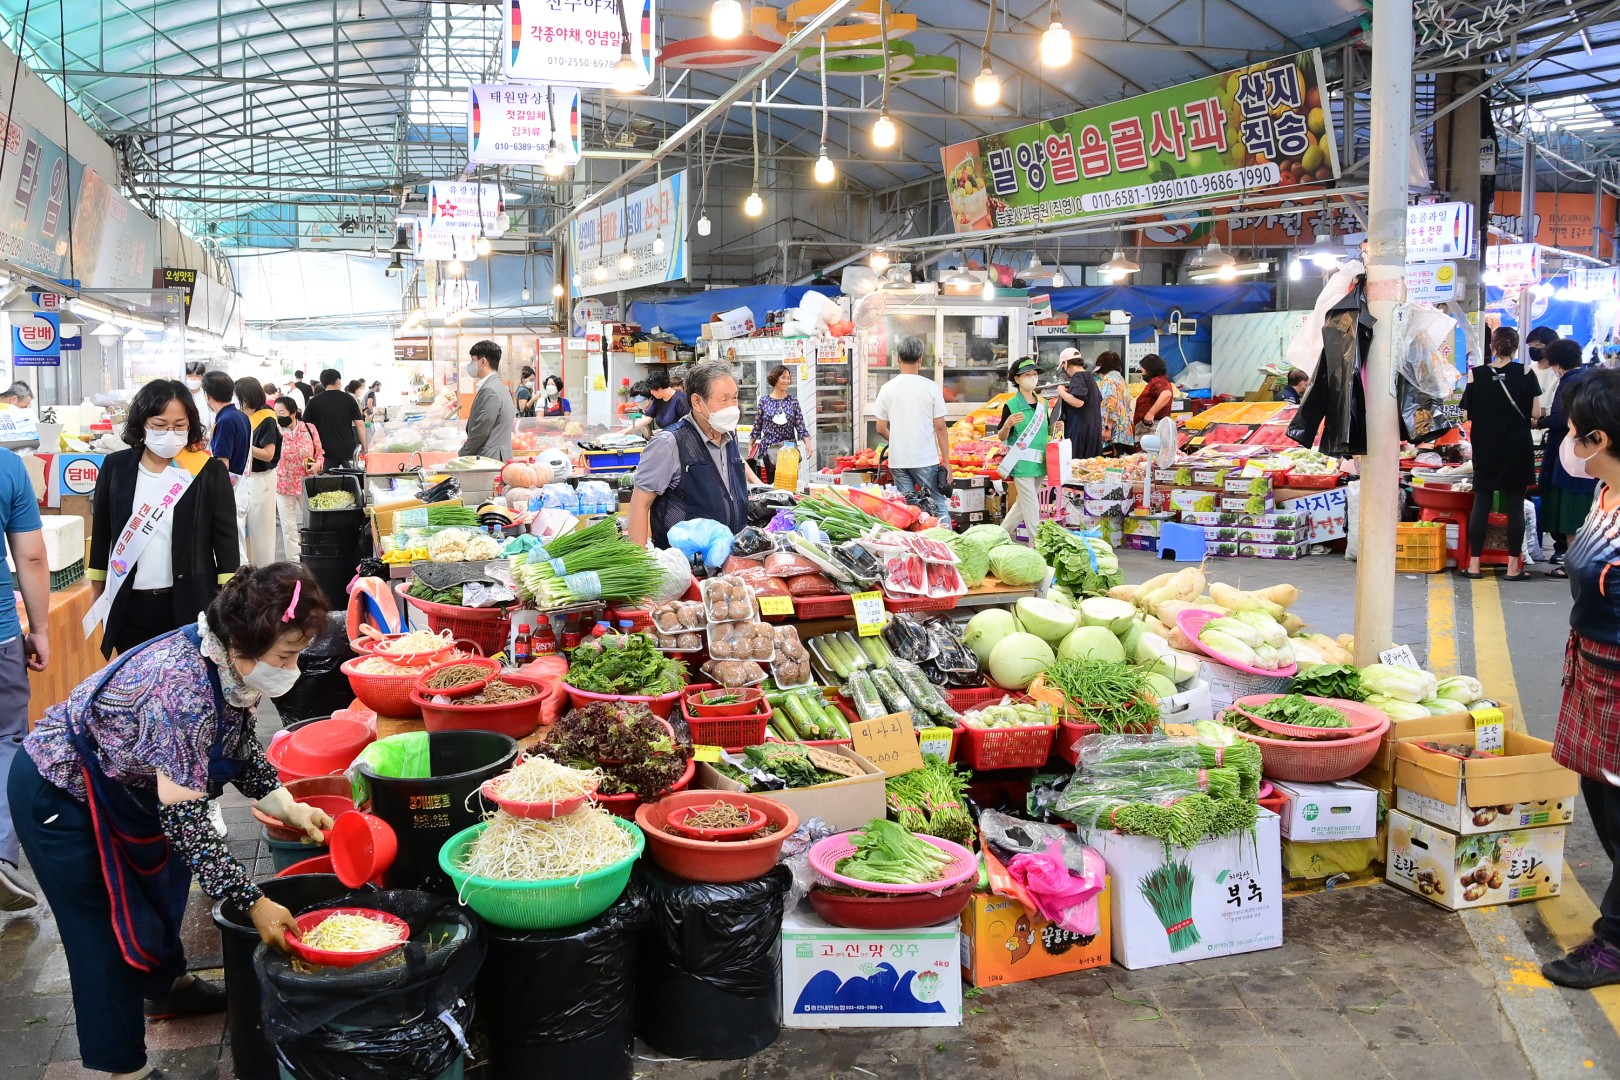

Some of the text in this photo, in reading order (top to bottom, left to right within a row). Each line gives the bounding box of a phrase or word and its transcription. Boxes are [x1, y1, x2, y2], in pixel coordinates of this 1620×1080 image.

[585, 29, 633, 47] 양념일
[1235, 62, 1302, 118] 산지
[511, 126, 541, 137] 김치류
[1241, 110, 1309, 161] 직송
[495, 142, 550, 152] 010-6389-583
[1409, 210, 1447, 225] 음골과일
[164, 270, 195, 283] 오성맛집
[22, 326, 52, 341] 담배
[68, 468, 98, 482] 담배
[115, 503, 152, 556] 전통시장
[862, 717, 904, 741] 미나리
[1229, 870, 1251, 881] 치악산
[1507, 856, 1544, 880] 토란
[1226, 878, 1263, 908] 부추
[889, 943, 920, 958] 상추
[933, 960, 950, 968] 4kg
